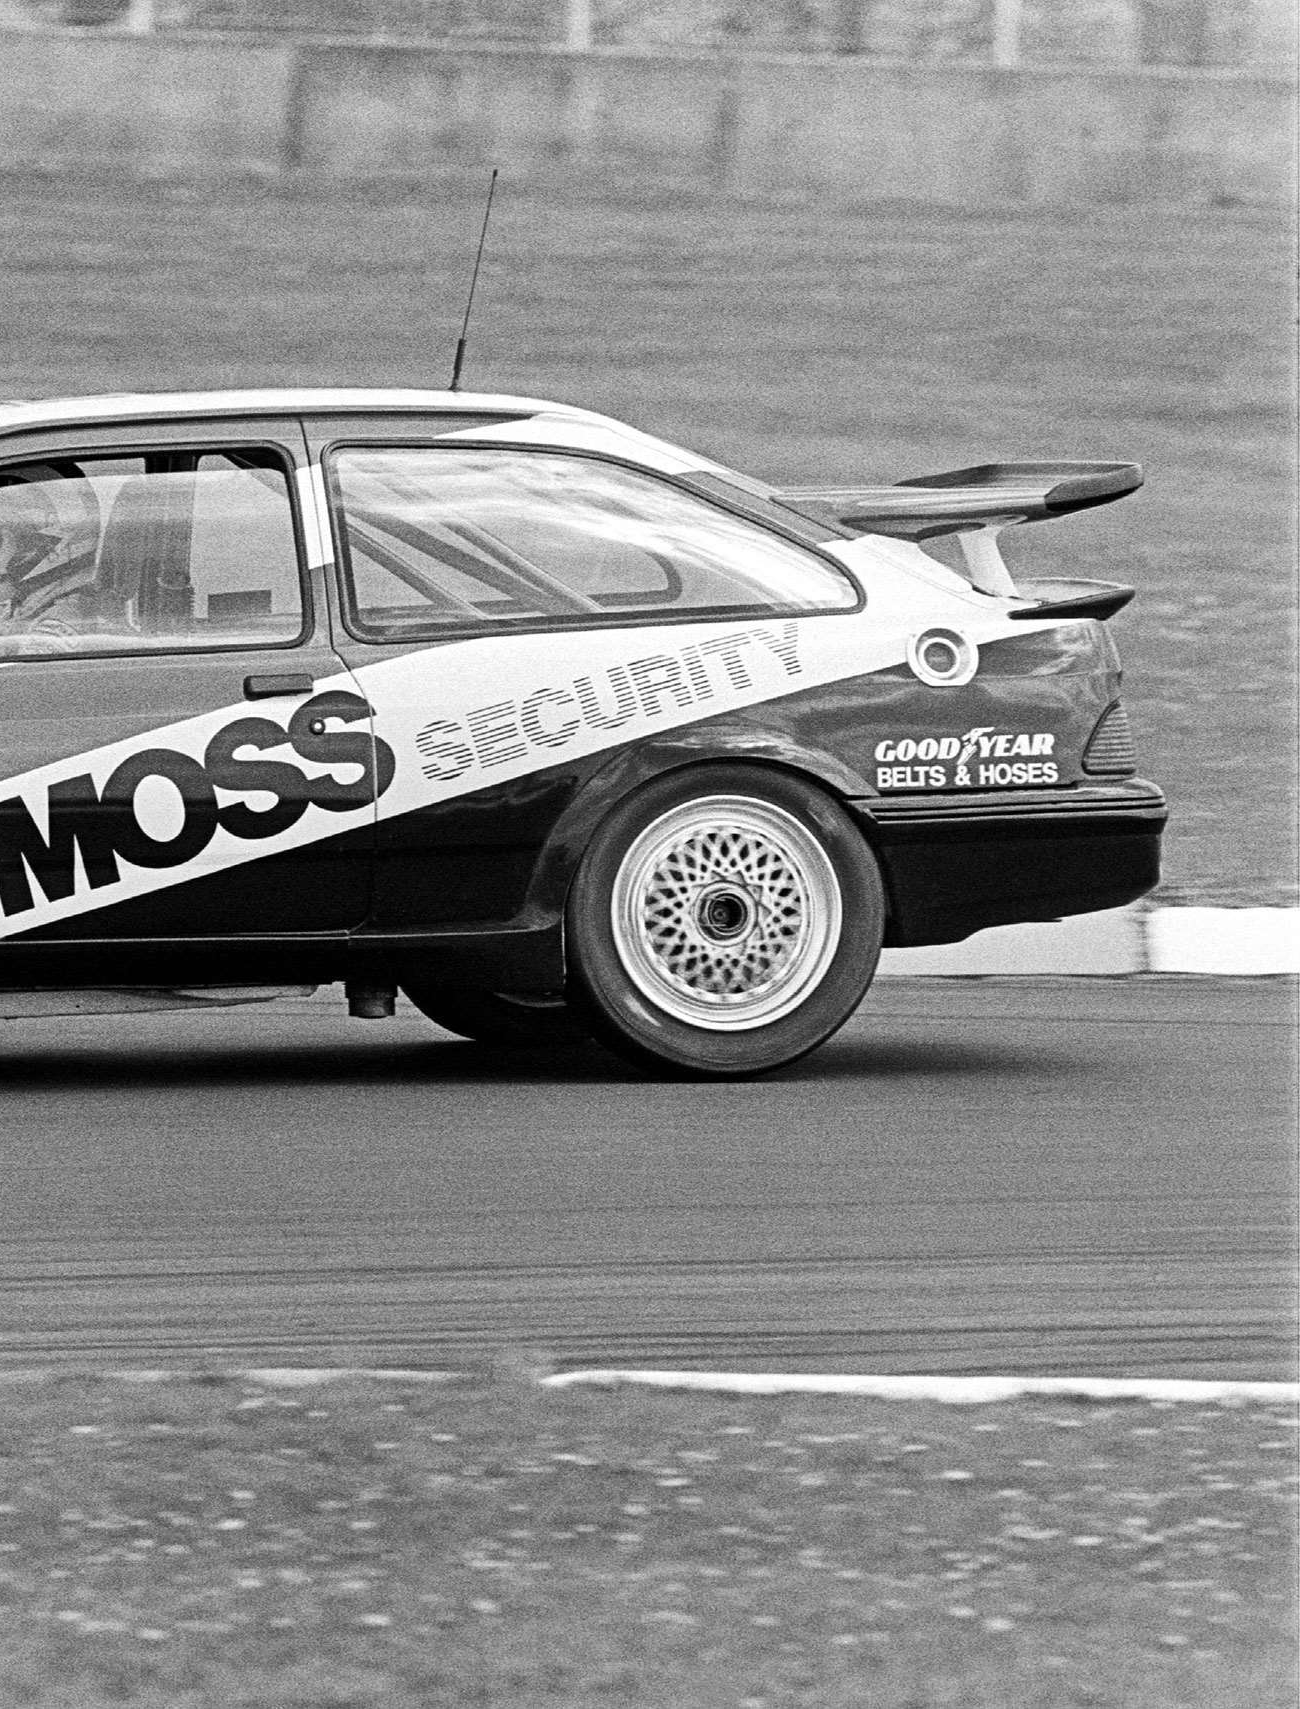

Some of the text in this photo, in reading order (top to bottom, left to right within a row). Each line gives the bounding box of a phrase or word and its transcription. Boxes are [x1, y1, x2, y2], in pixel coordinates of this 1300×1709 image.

[416, 622, 803, 782] SECURITY
[877, 762, 1059, 788] BELTS & HOSES
